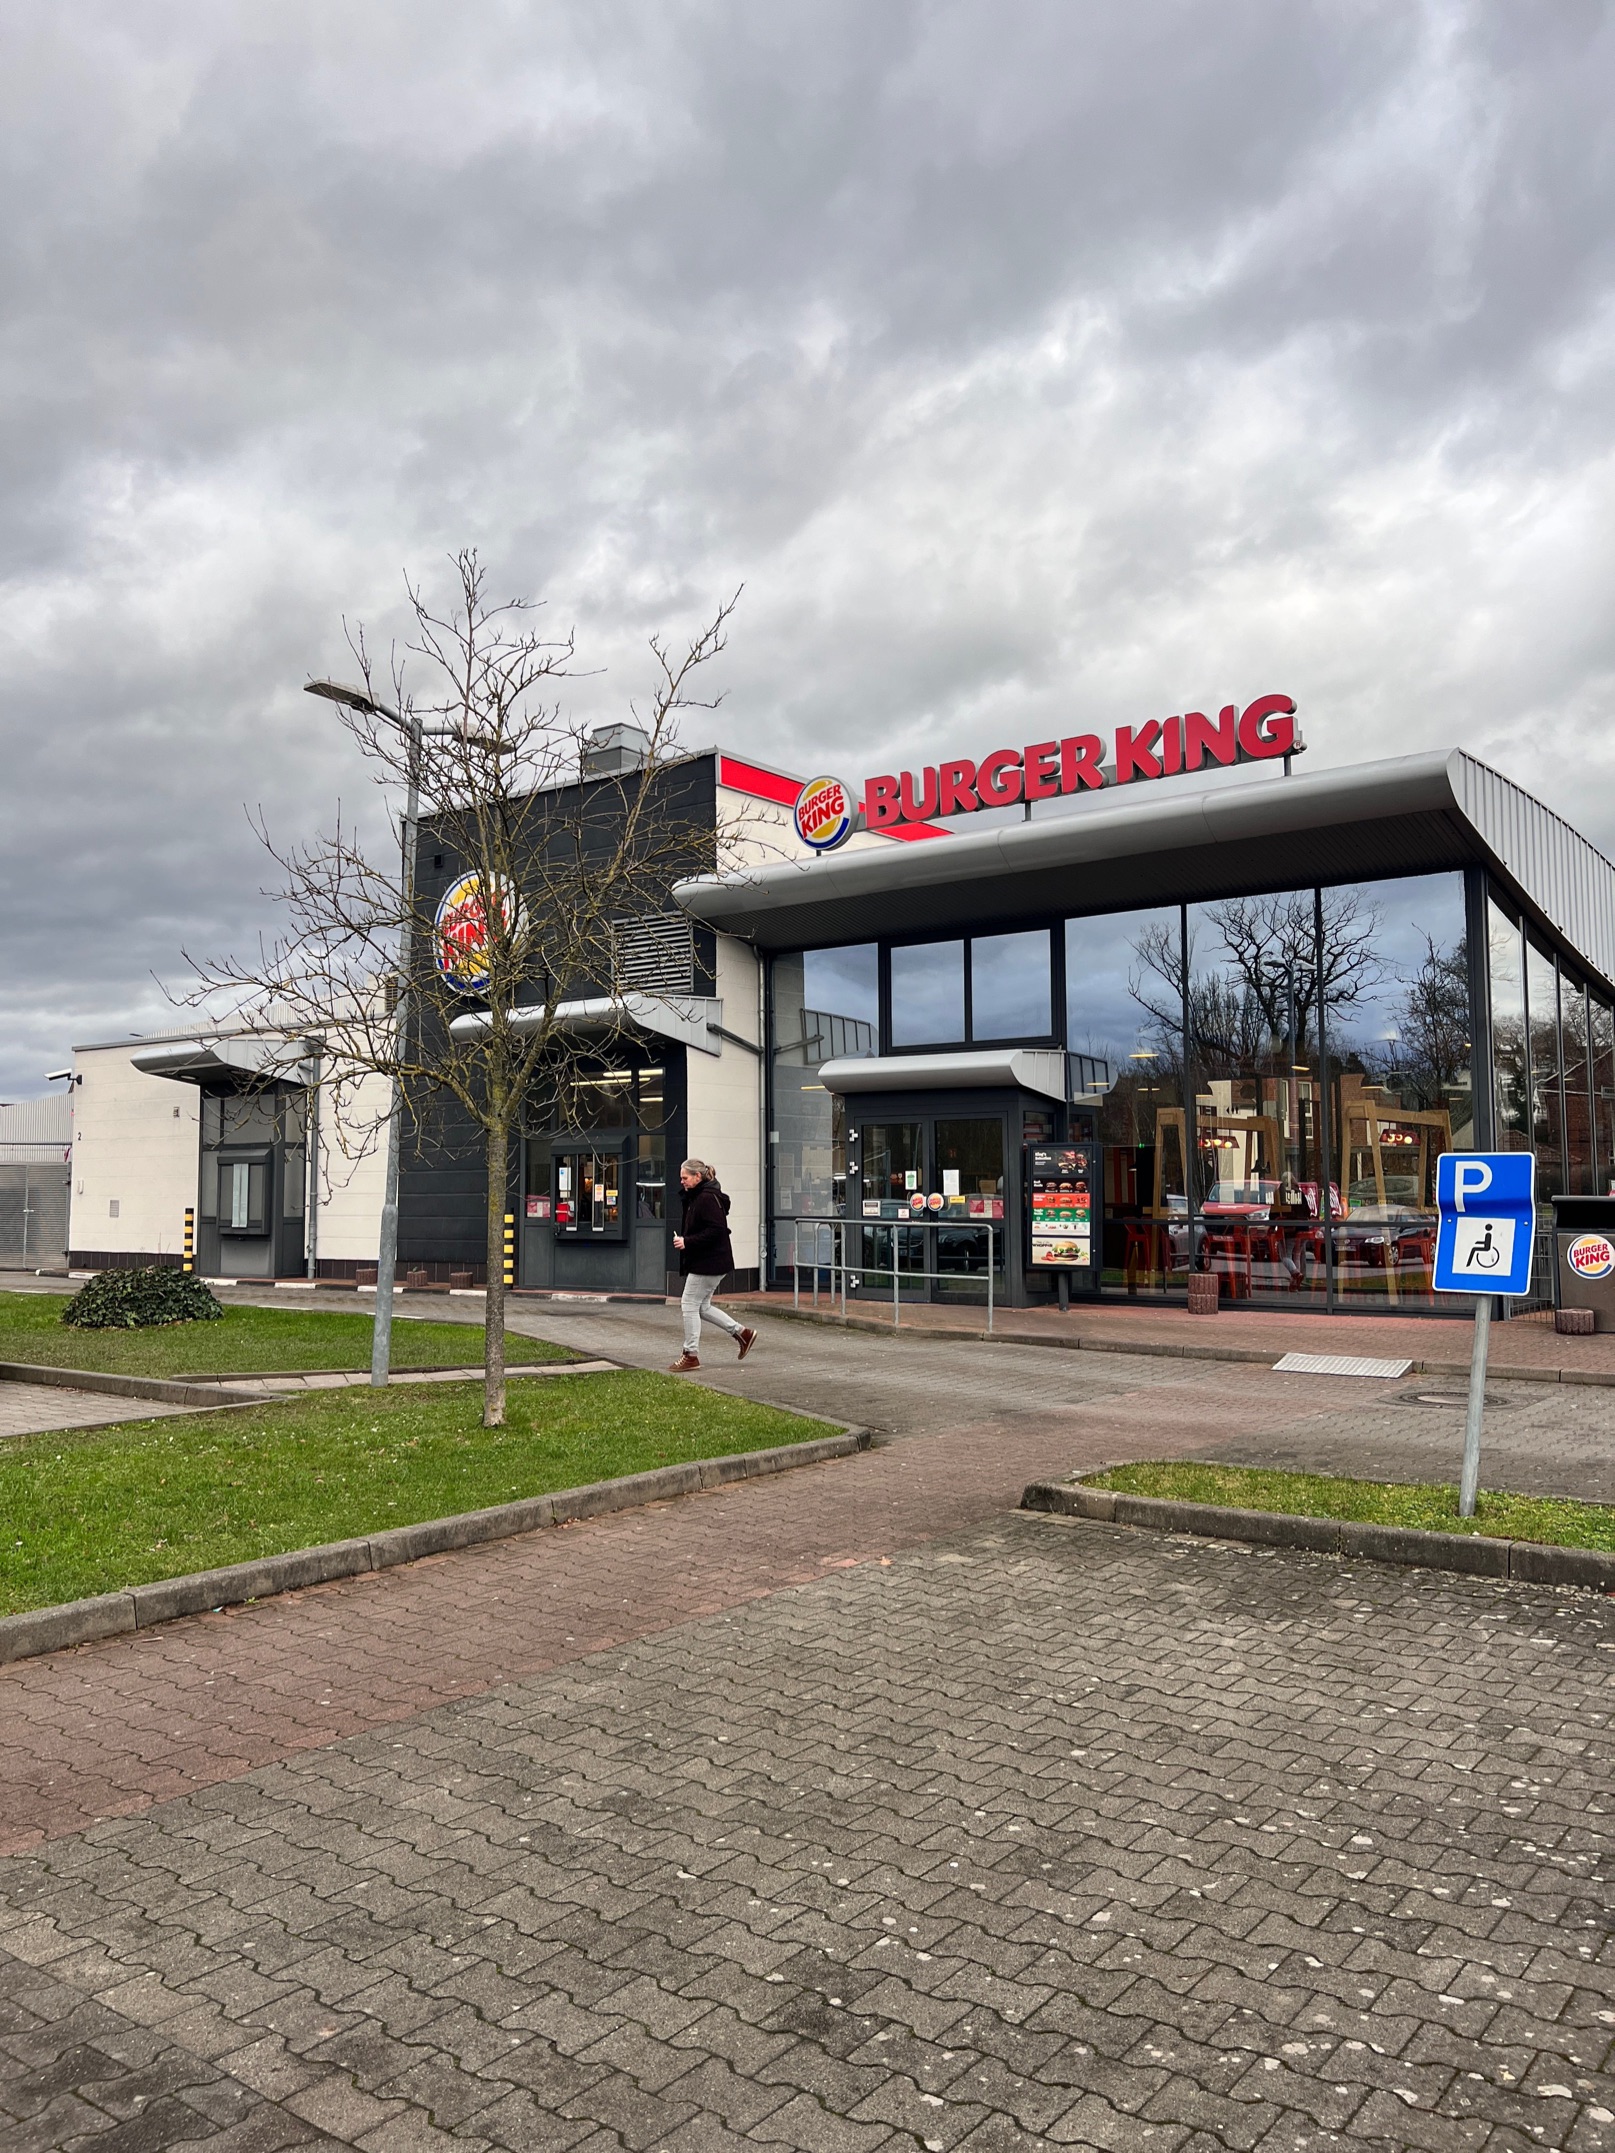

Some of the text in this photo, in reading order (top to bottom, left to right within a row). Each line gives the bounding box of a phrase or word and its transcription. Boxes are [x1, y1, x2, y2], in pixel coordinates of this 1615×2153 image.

[865, 734, 1106, 829] BURGER
[1115, 693, 1295, 784] KING
[798, 784, 842, 822] BURGER
[801, 795, 845, 839] KING
[77, 1131, 82, 1141] 2
[1454, 1160, 1493, 1213] P
[1573, 1243, 1608, 1258] BURGER
[1575, 1250, 1610, 1269] KING
